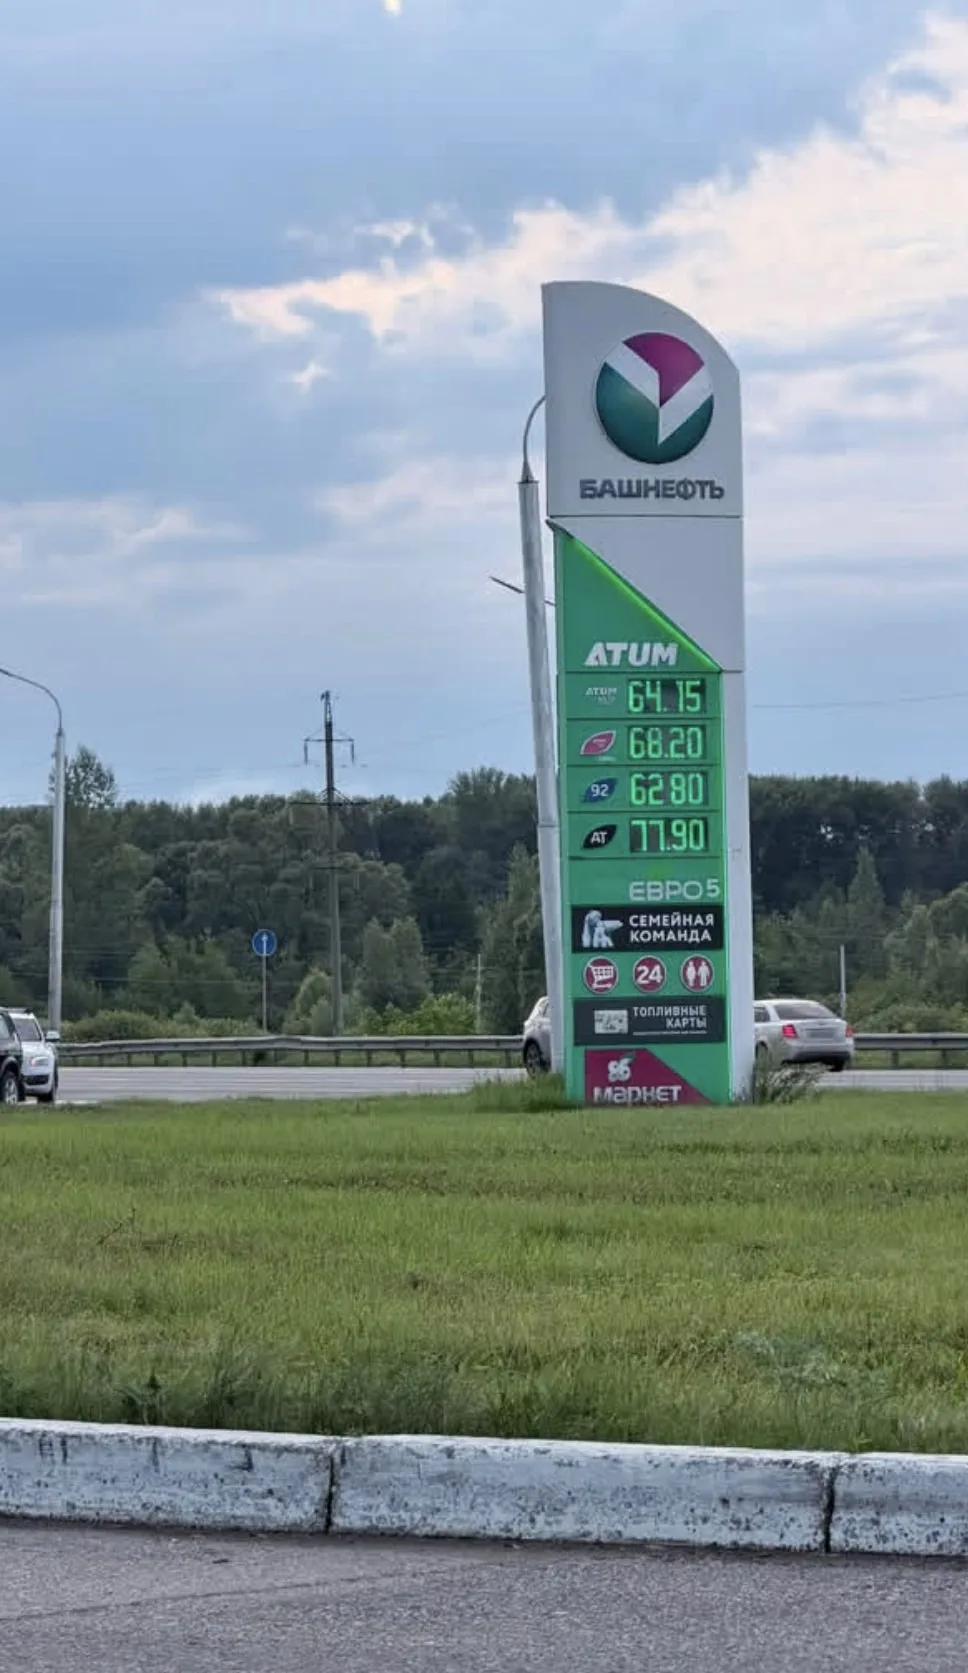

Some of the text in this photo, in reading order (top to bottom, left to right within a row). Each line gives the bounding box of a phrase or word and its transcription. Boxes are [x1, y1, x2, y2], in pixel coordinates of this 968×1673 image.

[579, 478, 725, 500] БАШНЕФТЬ
[584, 642, 678, 666] ATUM
[628, 680, 701, 712] 64.15
[630, 727, 702, 759] 68.20
[591, 784, 609, 796] 92
[631, 819, 704, 851] 77.90
[629, 879, 720, 901] ЕВРО 5
[629, 912, 715, 927] СЕМЕЙНАЯ
[630, 930, 712, 943] КОМАНДА
[637, 965, 663, 985] 24
[633, 1005, 707, 1017] ТОПЛИВНЫЕ
[666, 1017, 707, 1029] КАРТЫ
